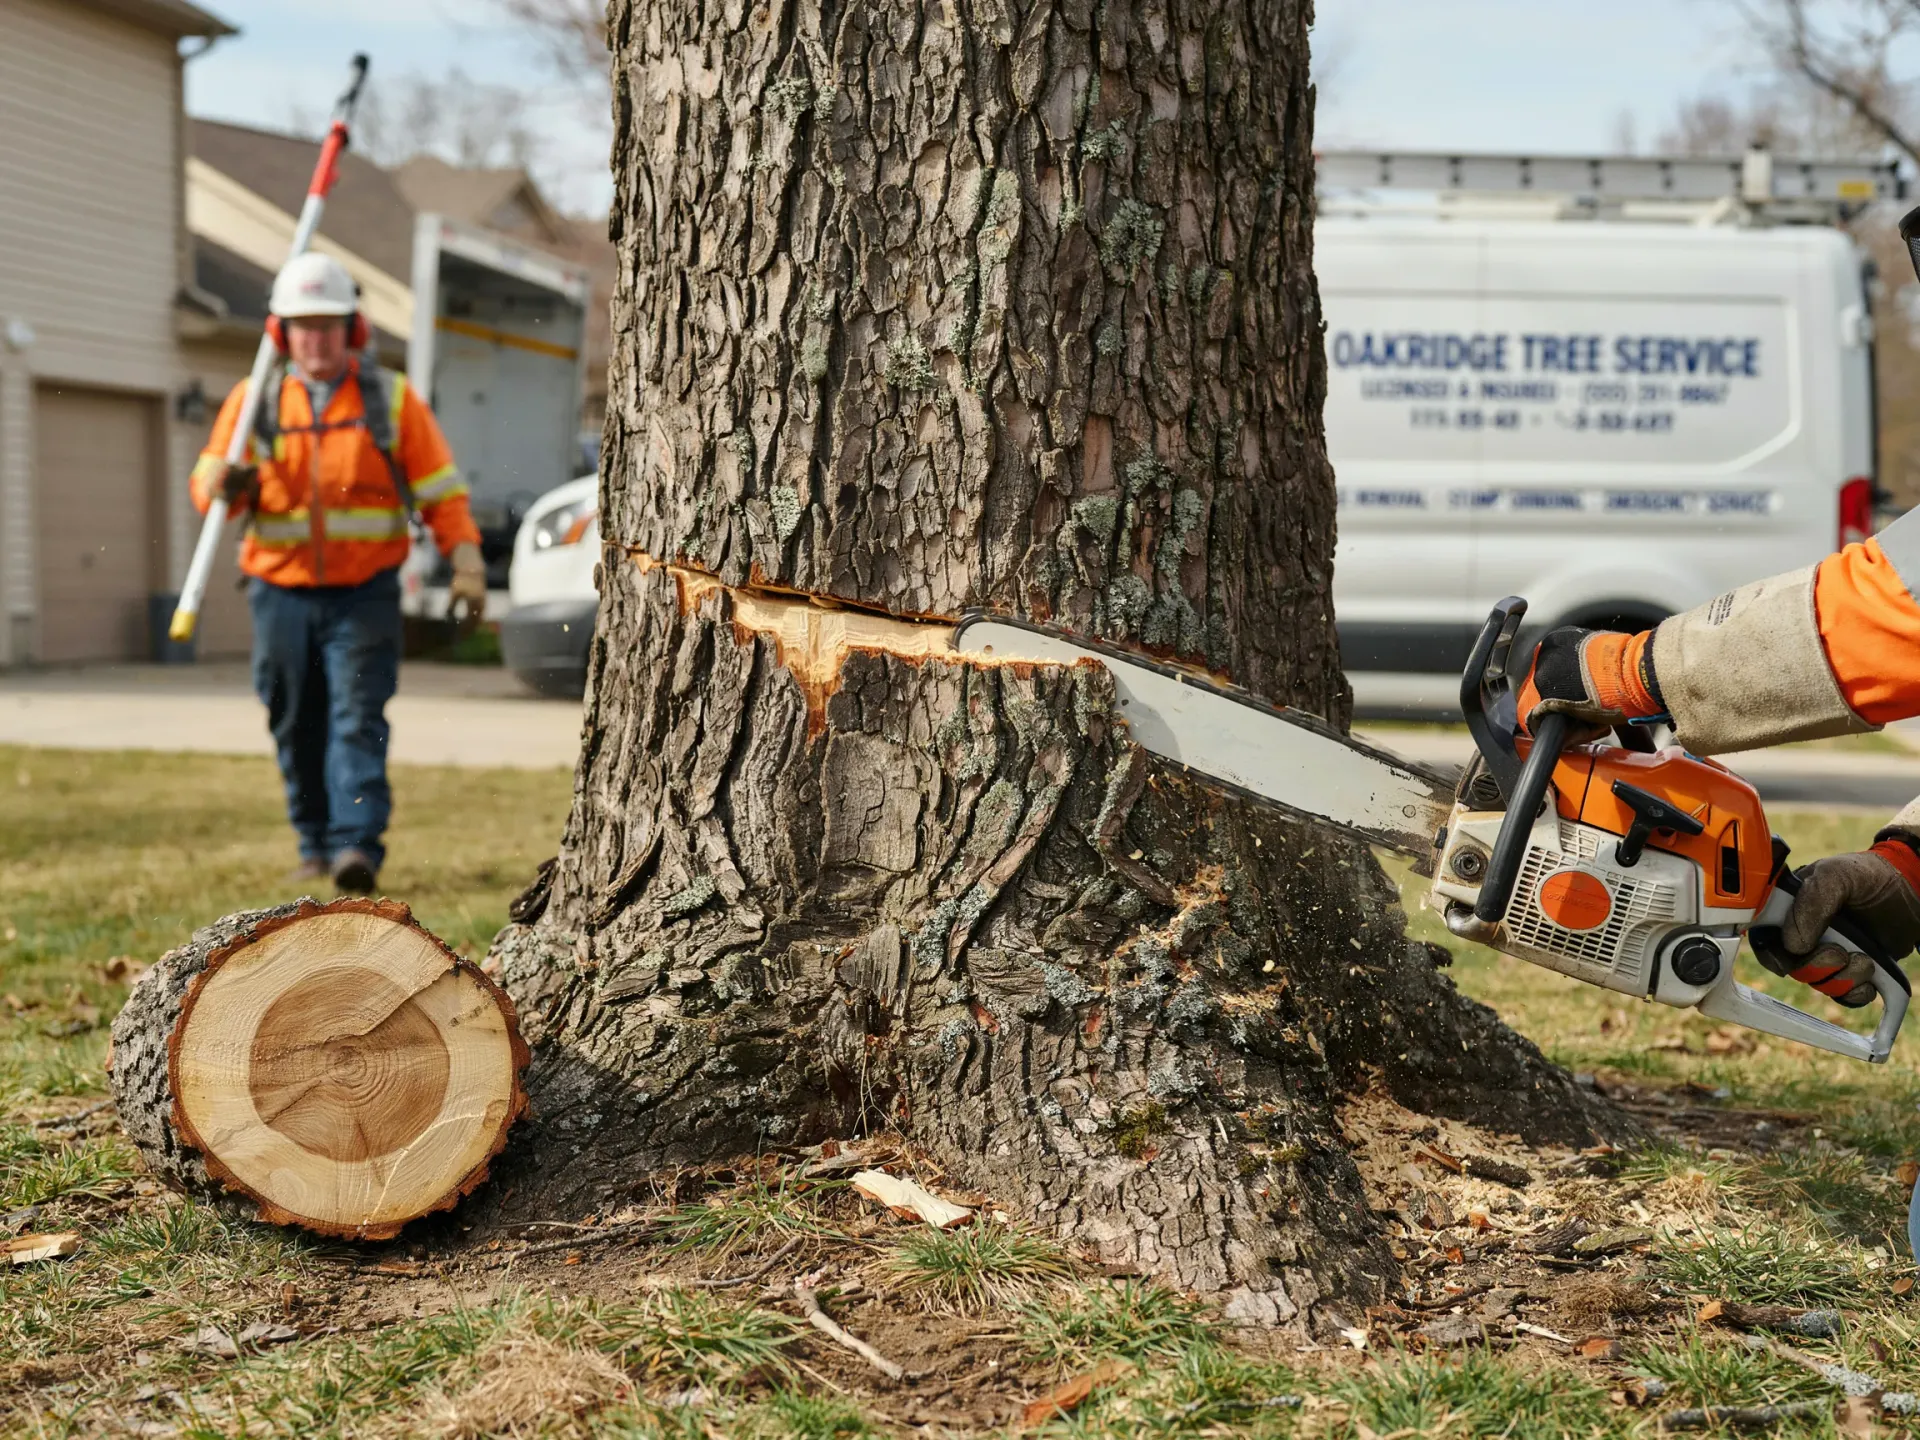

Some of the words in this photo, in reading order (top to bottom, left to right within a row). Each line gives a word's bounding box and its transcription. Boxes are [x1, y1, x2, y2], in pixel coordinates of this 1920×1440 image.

[1334, 333, 1507, 371] OAKRIDGE
[1522, 335, 1601, 373] TREE
[1614, 336, 1760, 377] SERVICE
